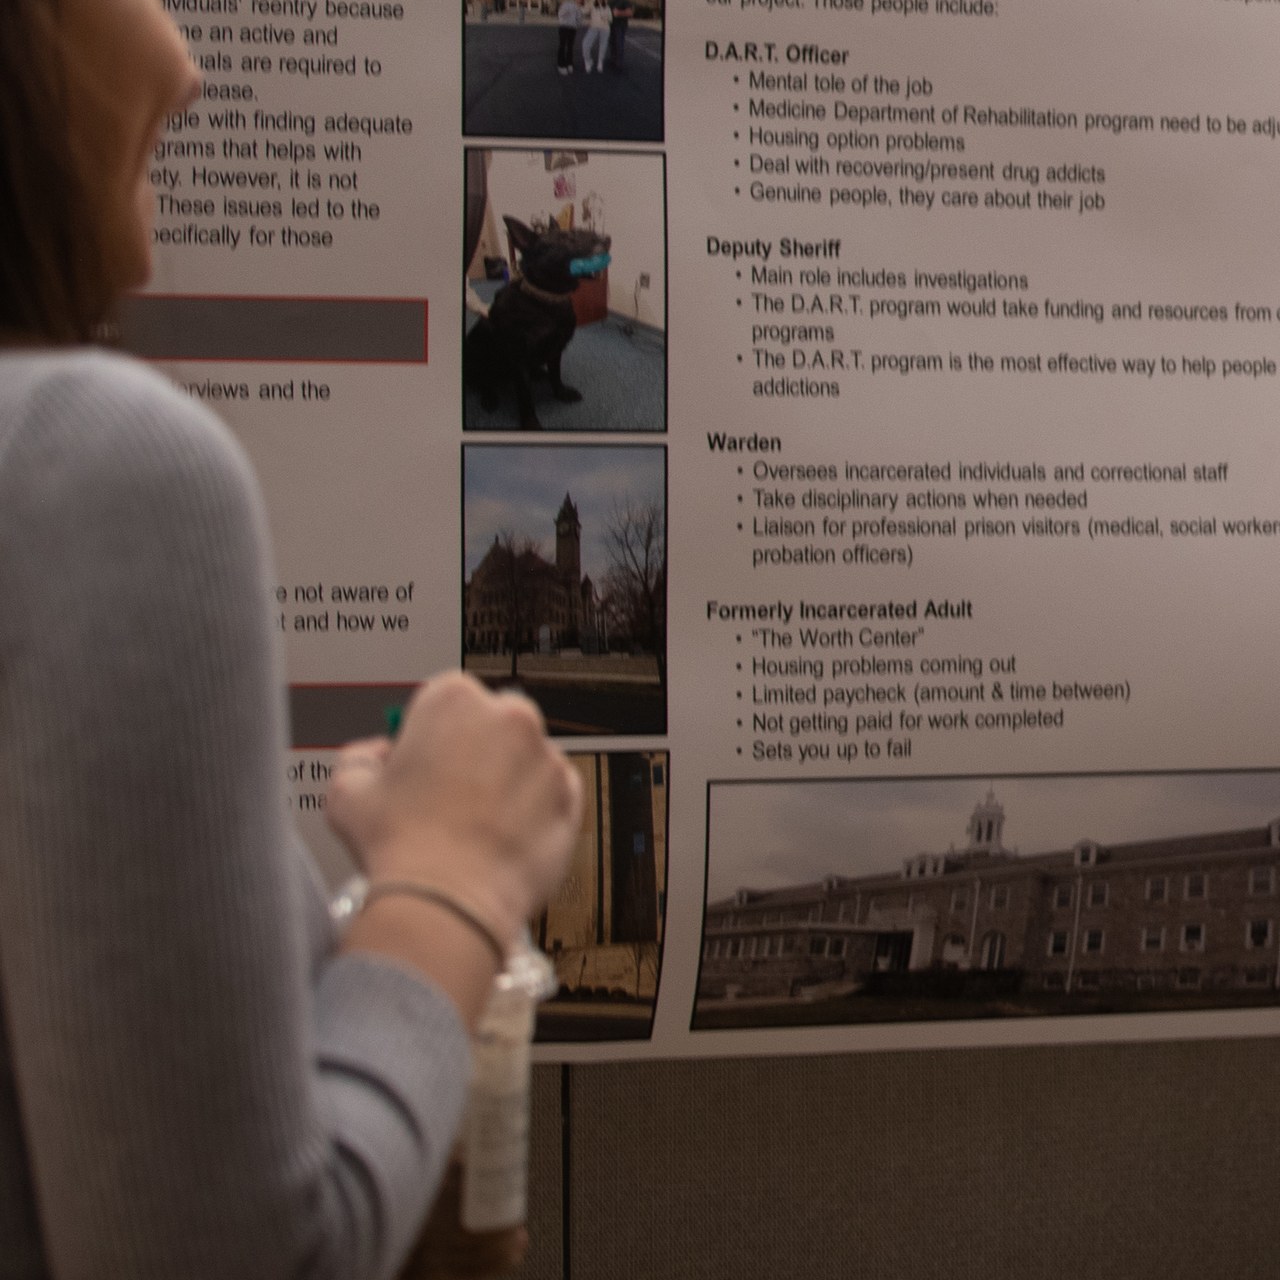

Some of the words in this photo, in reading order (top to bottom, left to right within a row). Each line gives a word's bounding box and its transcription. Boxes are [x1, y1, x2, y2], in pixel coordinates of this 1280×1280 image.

[208, 25, 233, 42] an
[239, 23, 295, 44] active
[302, 25, 338, 46] and
[704, 40, 778, 62] D.A.R.T.
[785, 43, 849, 64] Officer
[240, 56, 272, 72] are
[278, 54, 356, 78] required
[363, 56, 382, 75] to
[748, 69, 808, 91] Mental
[813, 73, 846, 92] tole
[850, 74, 868, 93] of
[873, 75, 900, 94] the
[905, 77, 933, 99] job
[207, 109, 246, 129] with
[253, 110, 316, 136] finding
[323, 112, 413, 137] adequate
[748, 97, 827, 120] Medicine
[833, 100, 935, 125] Department
[940, 104, 959, 124] of
[962, 105, 1078, 128] Rehabilitation
[1084, 114, 1154, 134] program
[1159, 114, 1201, 132] need
[1205, 115, 1222, 133] to
[1225, 115, 1247, 134] be
[221, 138, 258, 158] that
[265, 139, 316, 164] helps
[323, 141, 362, 161] with
[748, 125, 819, 152] Housing
[825, 130, 880, 152] option
[885, 131, 965, 154] problems
[191, 166, 281, 190] However,
[289, 168, 300, 189] it
[306, 169, 322, 189] is
[328, 171, 358, 190] not
[749, 153, 790, 174] Deal
[794, 155, 830, 175] with
[835, 159, 995, 183] recovering/present
[1001, 161, 1040, 185] drug
[1045, 163, 1106, 183] addicts
[158, 194, 215, 215] These
[222, 195, 283, 217] issues
[291, 197, 320, 218] led
[326, 199, 345, 218] to
[350, 198, 380, 219] the
[749, 180, 822, 202] Genuine
[829, 185, 892, 208] people,
[898, 186, 935, 210] they
[940, 191, 979, 206] care
[983, 188, 1031, 208] about
[1036, 190, 1073, 209] their
[1078, 191, 1106, 214] job
[248, 225, 275, 246] for
[280, 225, 333, 246] those
[706, 236, 772, 261] Deputy
[779, 237, 841, 258] Sheriff
[750, 264, 793, 285] Main
[799, 267, 831, 285] role
[836, 267, 907, 287] includes
[913, 269, 1029, 293] investigations
[706, 432, 782, 451] Warden
[752, 460, 838, 480] Oversees
[844, 461, 951, 481] incarcerated
[958, 462, 1047, 481] individuals
[1053, 462, 1085, 481] and
[1089, 463, 1187, 481] correctional
[1192, 462, 1229, 482] staff
[294, 582, 324, 602] not
[330, 586, 389, 602] aware
[395, 581, 414, 601] of
[293, 611, 329, 631] and
[336, 611, 375, 631] how
[380, 615, 409, 631] we
[706, 600, 793, 624] Formerly
[799, 599, 917, 619] Incarcerated
[923, 599, 973, 618] Adult
[751, 628, 793, 648] "The
[798, 628, 854, 648] Worth
[858, 627, 925, 646] Center"
[751, 656, 824, 680] Housing
[831, 655, 914, 679] problems
[919, 654, 983, 678] coming
[988, 655, 1016, 673] out
[751, 684, 817, 704] Limited
[822, 683, 906, 708] paycheck
[913, 683, 985, 706] (amount
[990, 681, 1004, 700] &
[1009, 682, 1047, 700] time
[1051, 681, 1131, 701] between)
